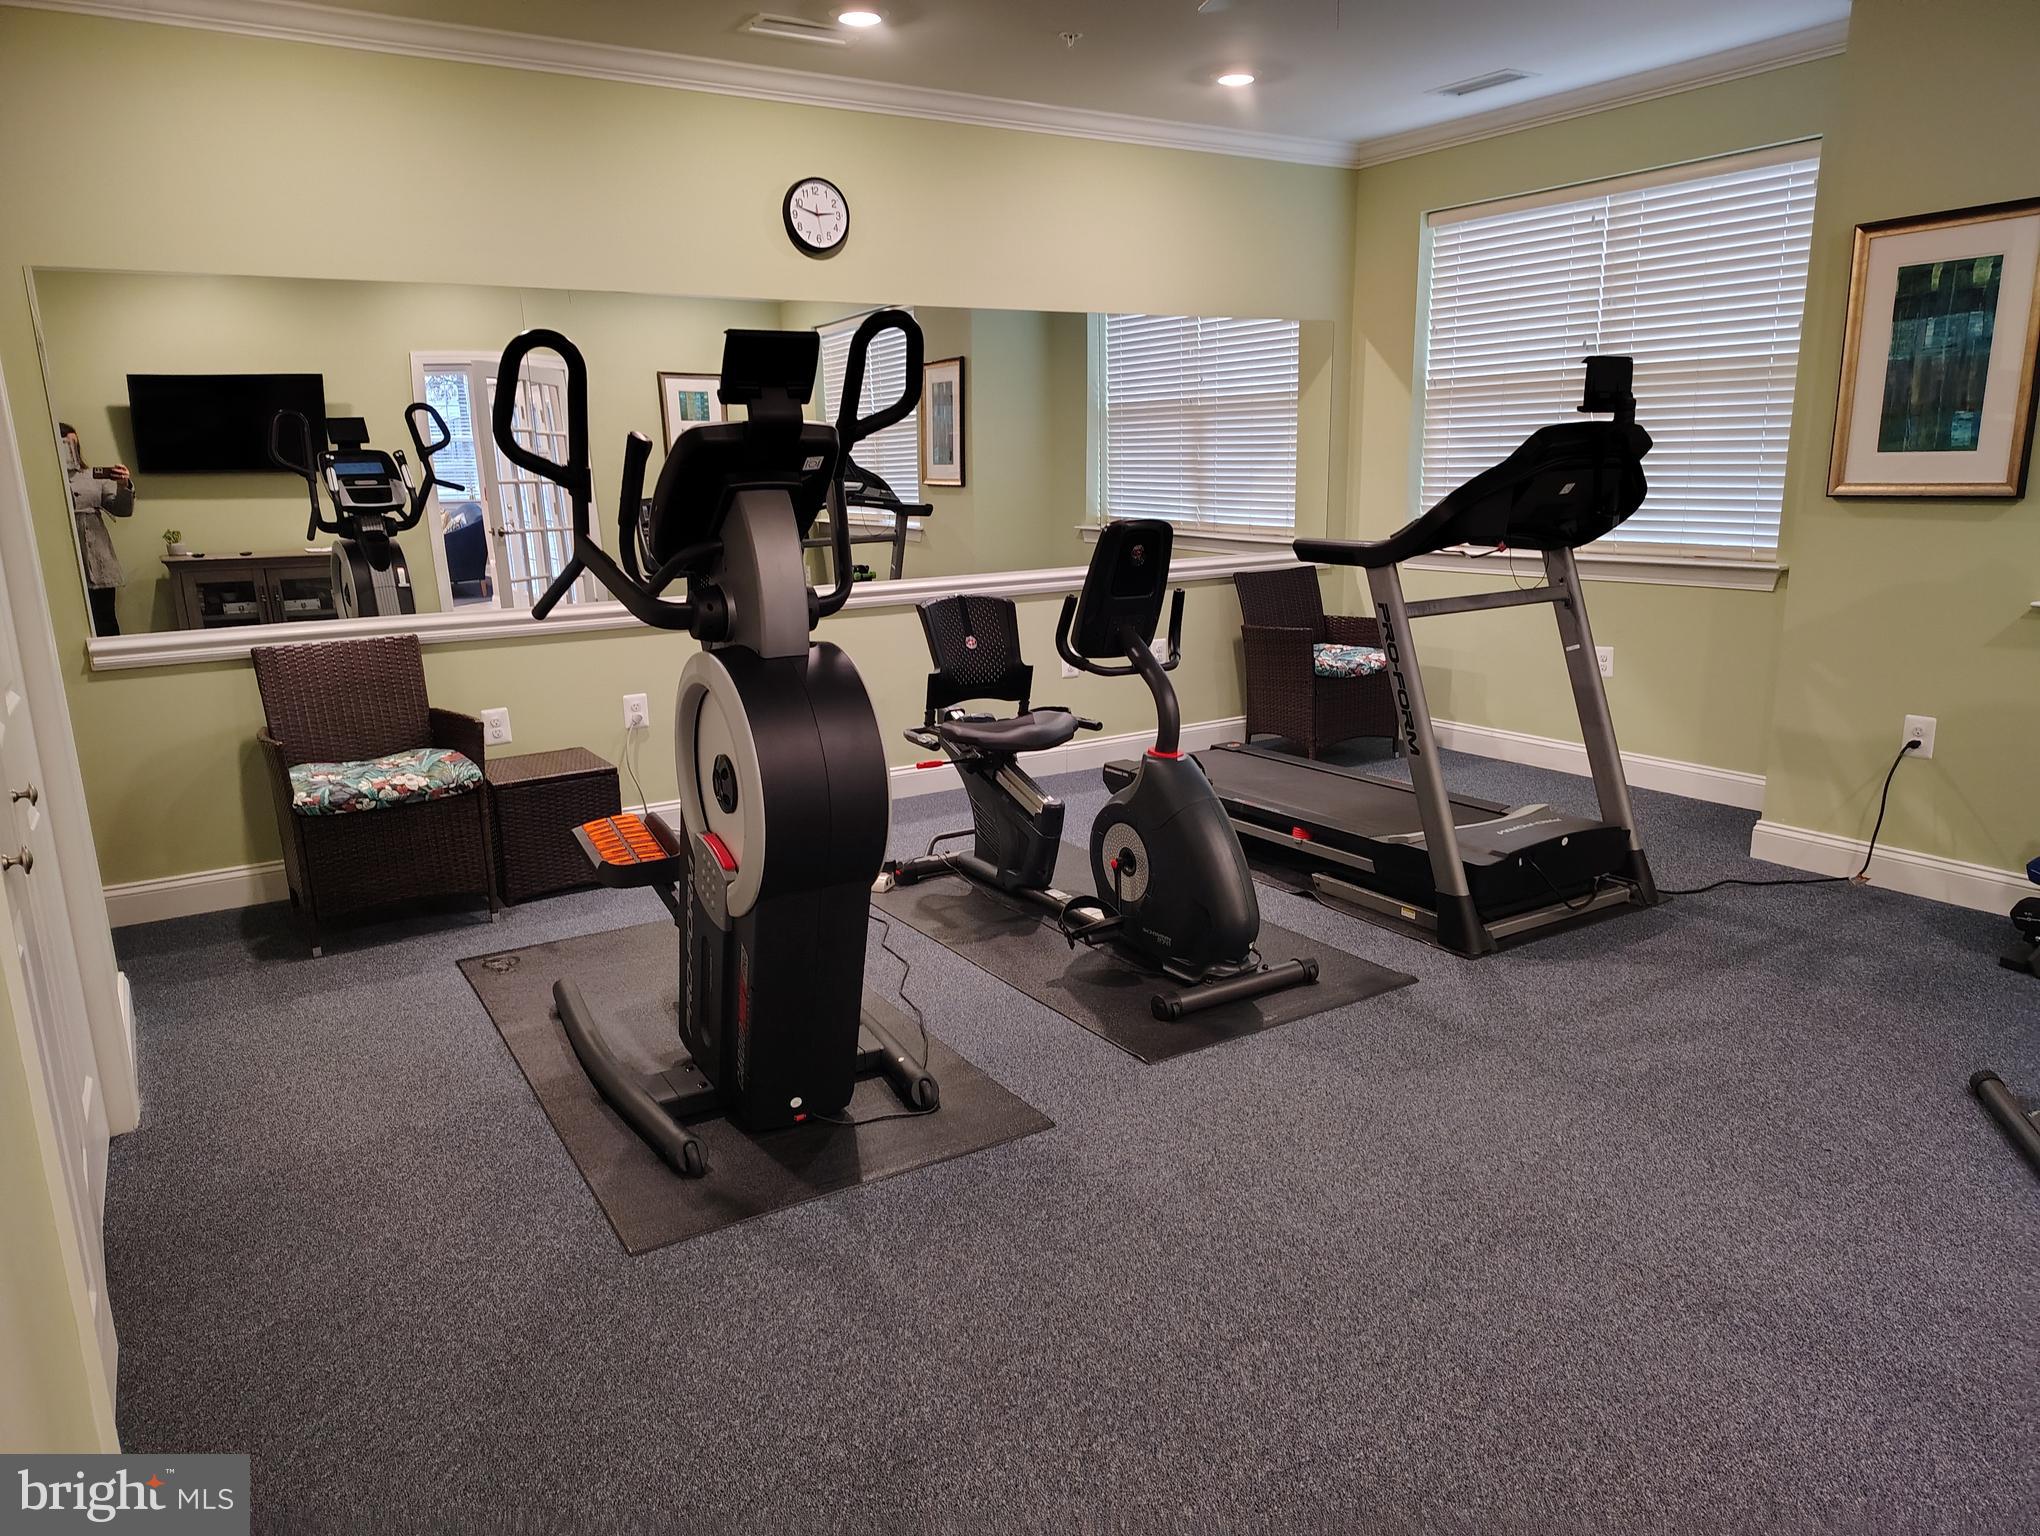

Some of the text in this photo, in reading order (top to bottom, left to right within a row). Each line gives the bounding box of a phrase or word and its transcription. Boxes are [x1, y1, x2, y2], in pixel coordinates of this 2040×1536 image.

[802, 189, 809, 198] 11
[811, 186, 819, 196] 12
[824, 190, 828, 199] 1
[795, 198, 803, 208] 10
[831, 199, 837, 209] 2
[792, 209, 798, 219] 9
[835, 211, 841, 220] 3
[797, 222, 803, 231] 8
[833, 223, 839, 232] 4
[806, 231, 812, 240] 7
[816, 234, 822, 243] 6
[826, 231, 832, 240] 5
[1377, 602, 1421, 756] PRO-FORM
